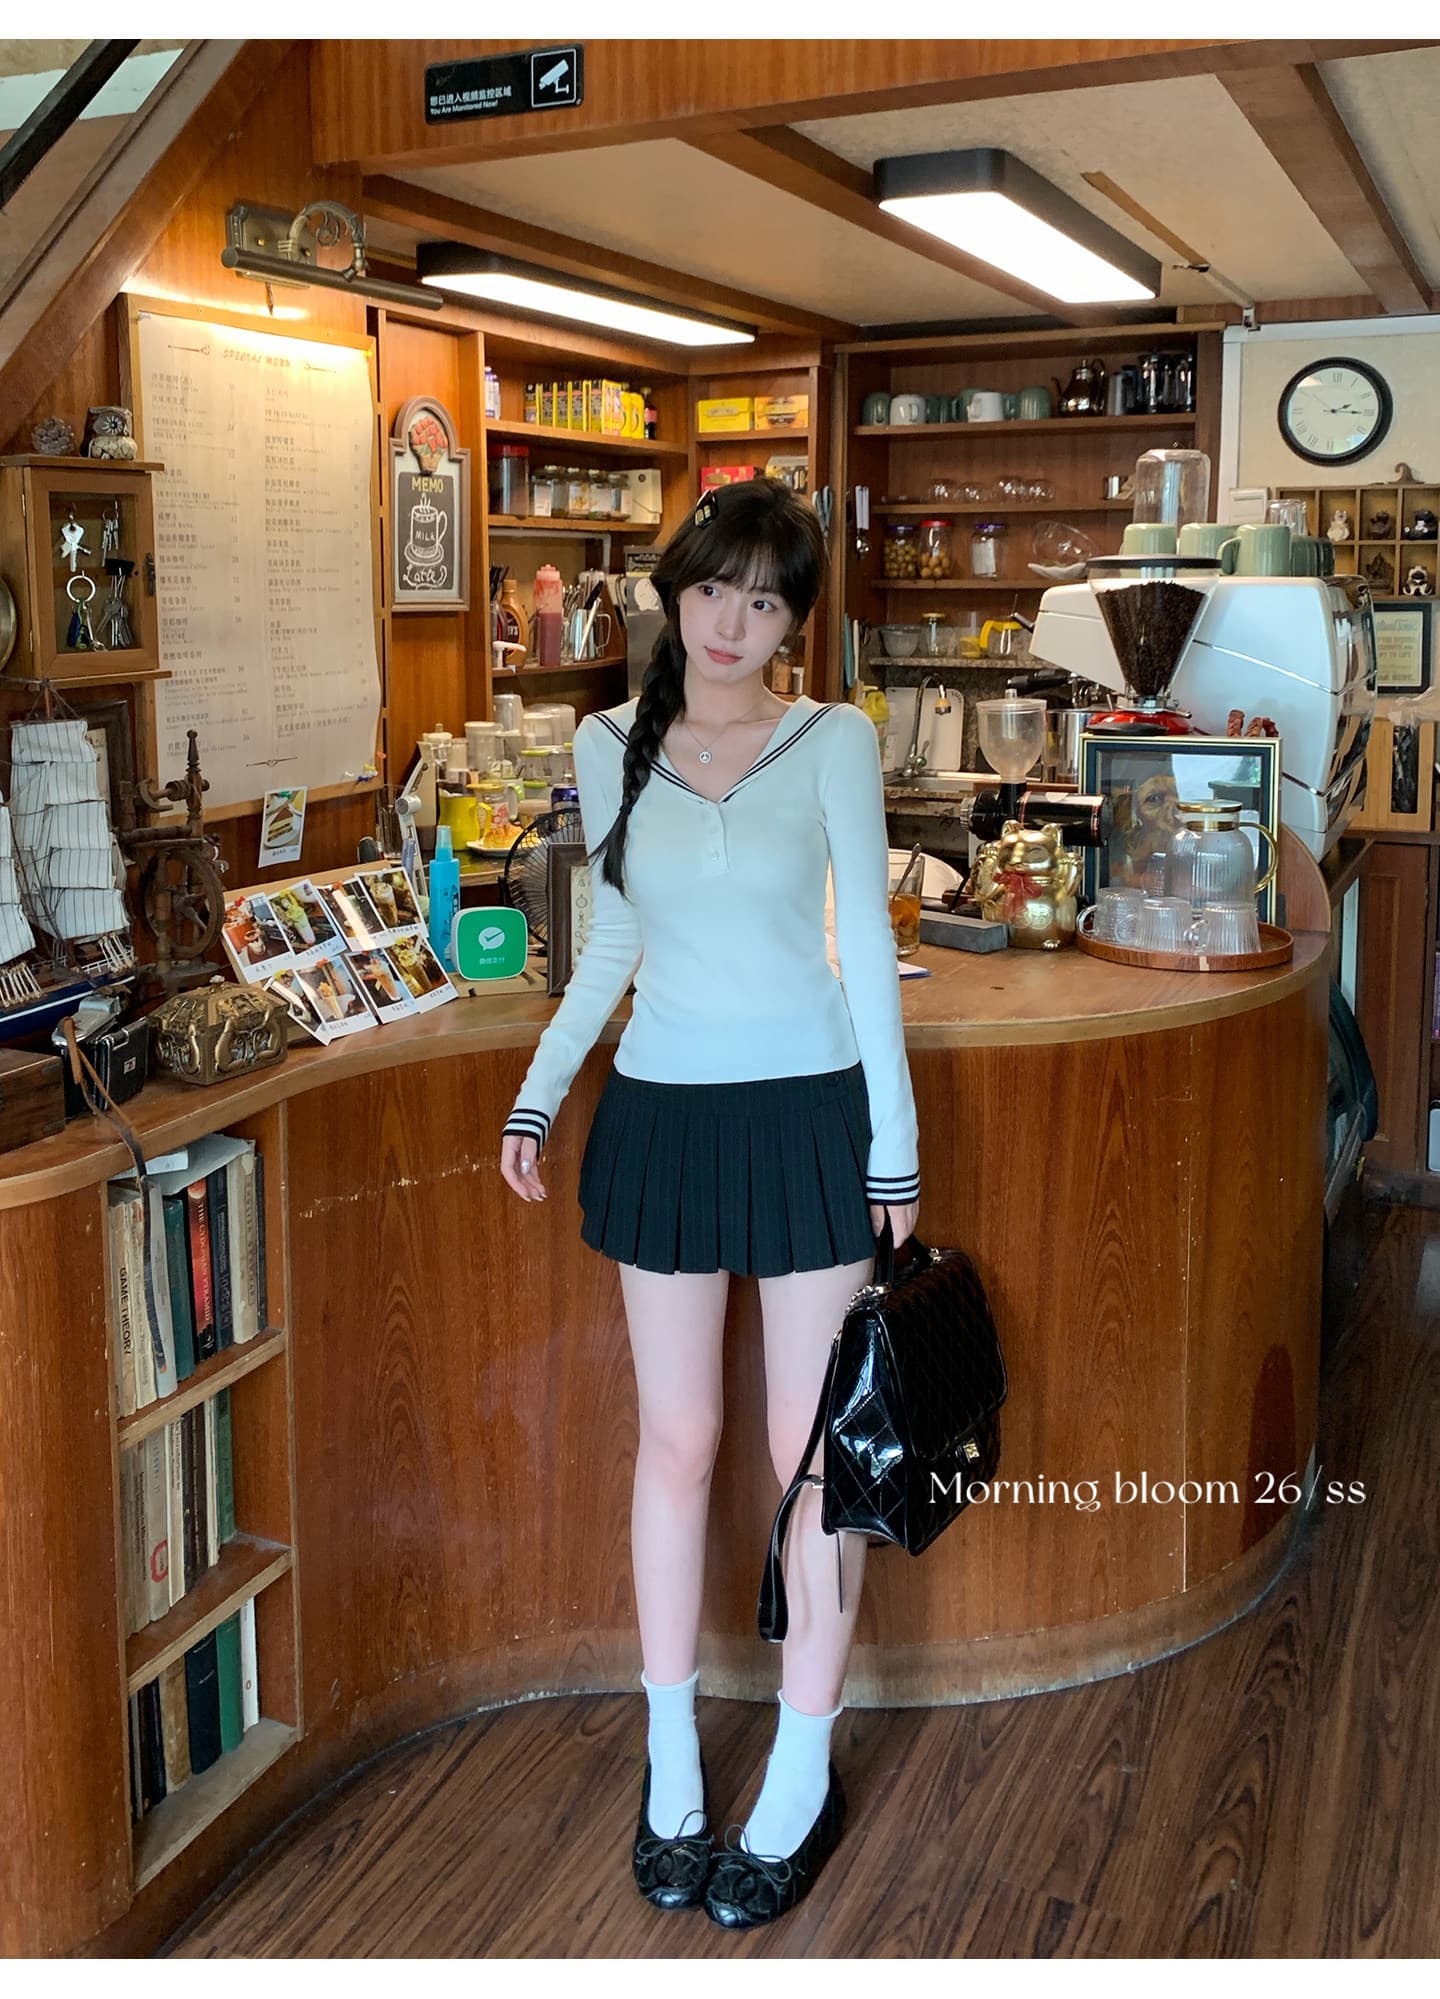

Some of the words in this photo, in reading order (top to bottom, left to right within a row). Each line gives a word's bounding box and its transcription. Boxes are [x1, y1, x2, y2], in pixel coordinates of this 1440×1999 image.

[430, 85, 512, 107] 您已进入视频监控区域
[453, 102, 482, 111] Monitored
[411, 477, 444, 493] MEMO
[415, 530, 436, 541] MILK
[479, 957, 505, 965] 微信支付
[119, 1267, 128, 1305] GAME
[203, 1276, 211, 1321] PYRAMID
[121, 1307, 132, 1354] THEORY
